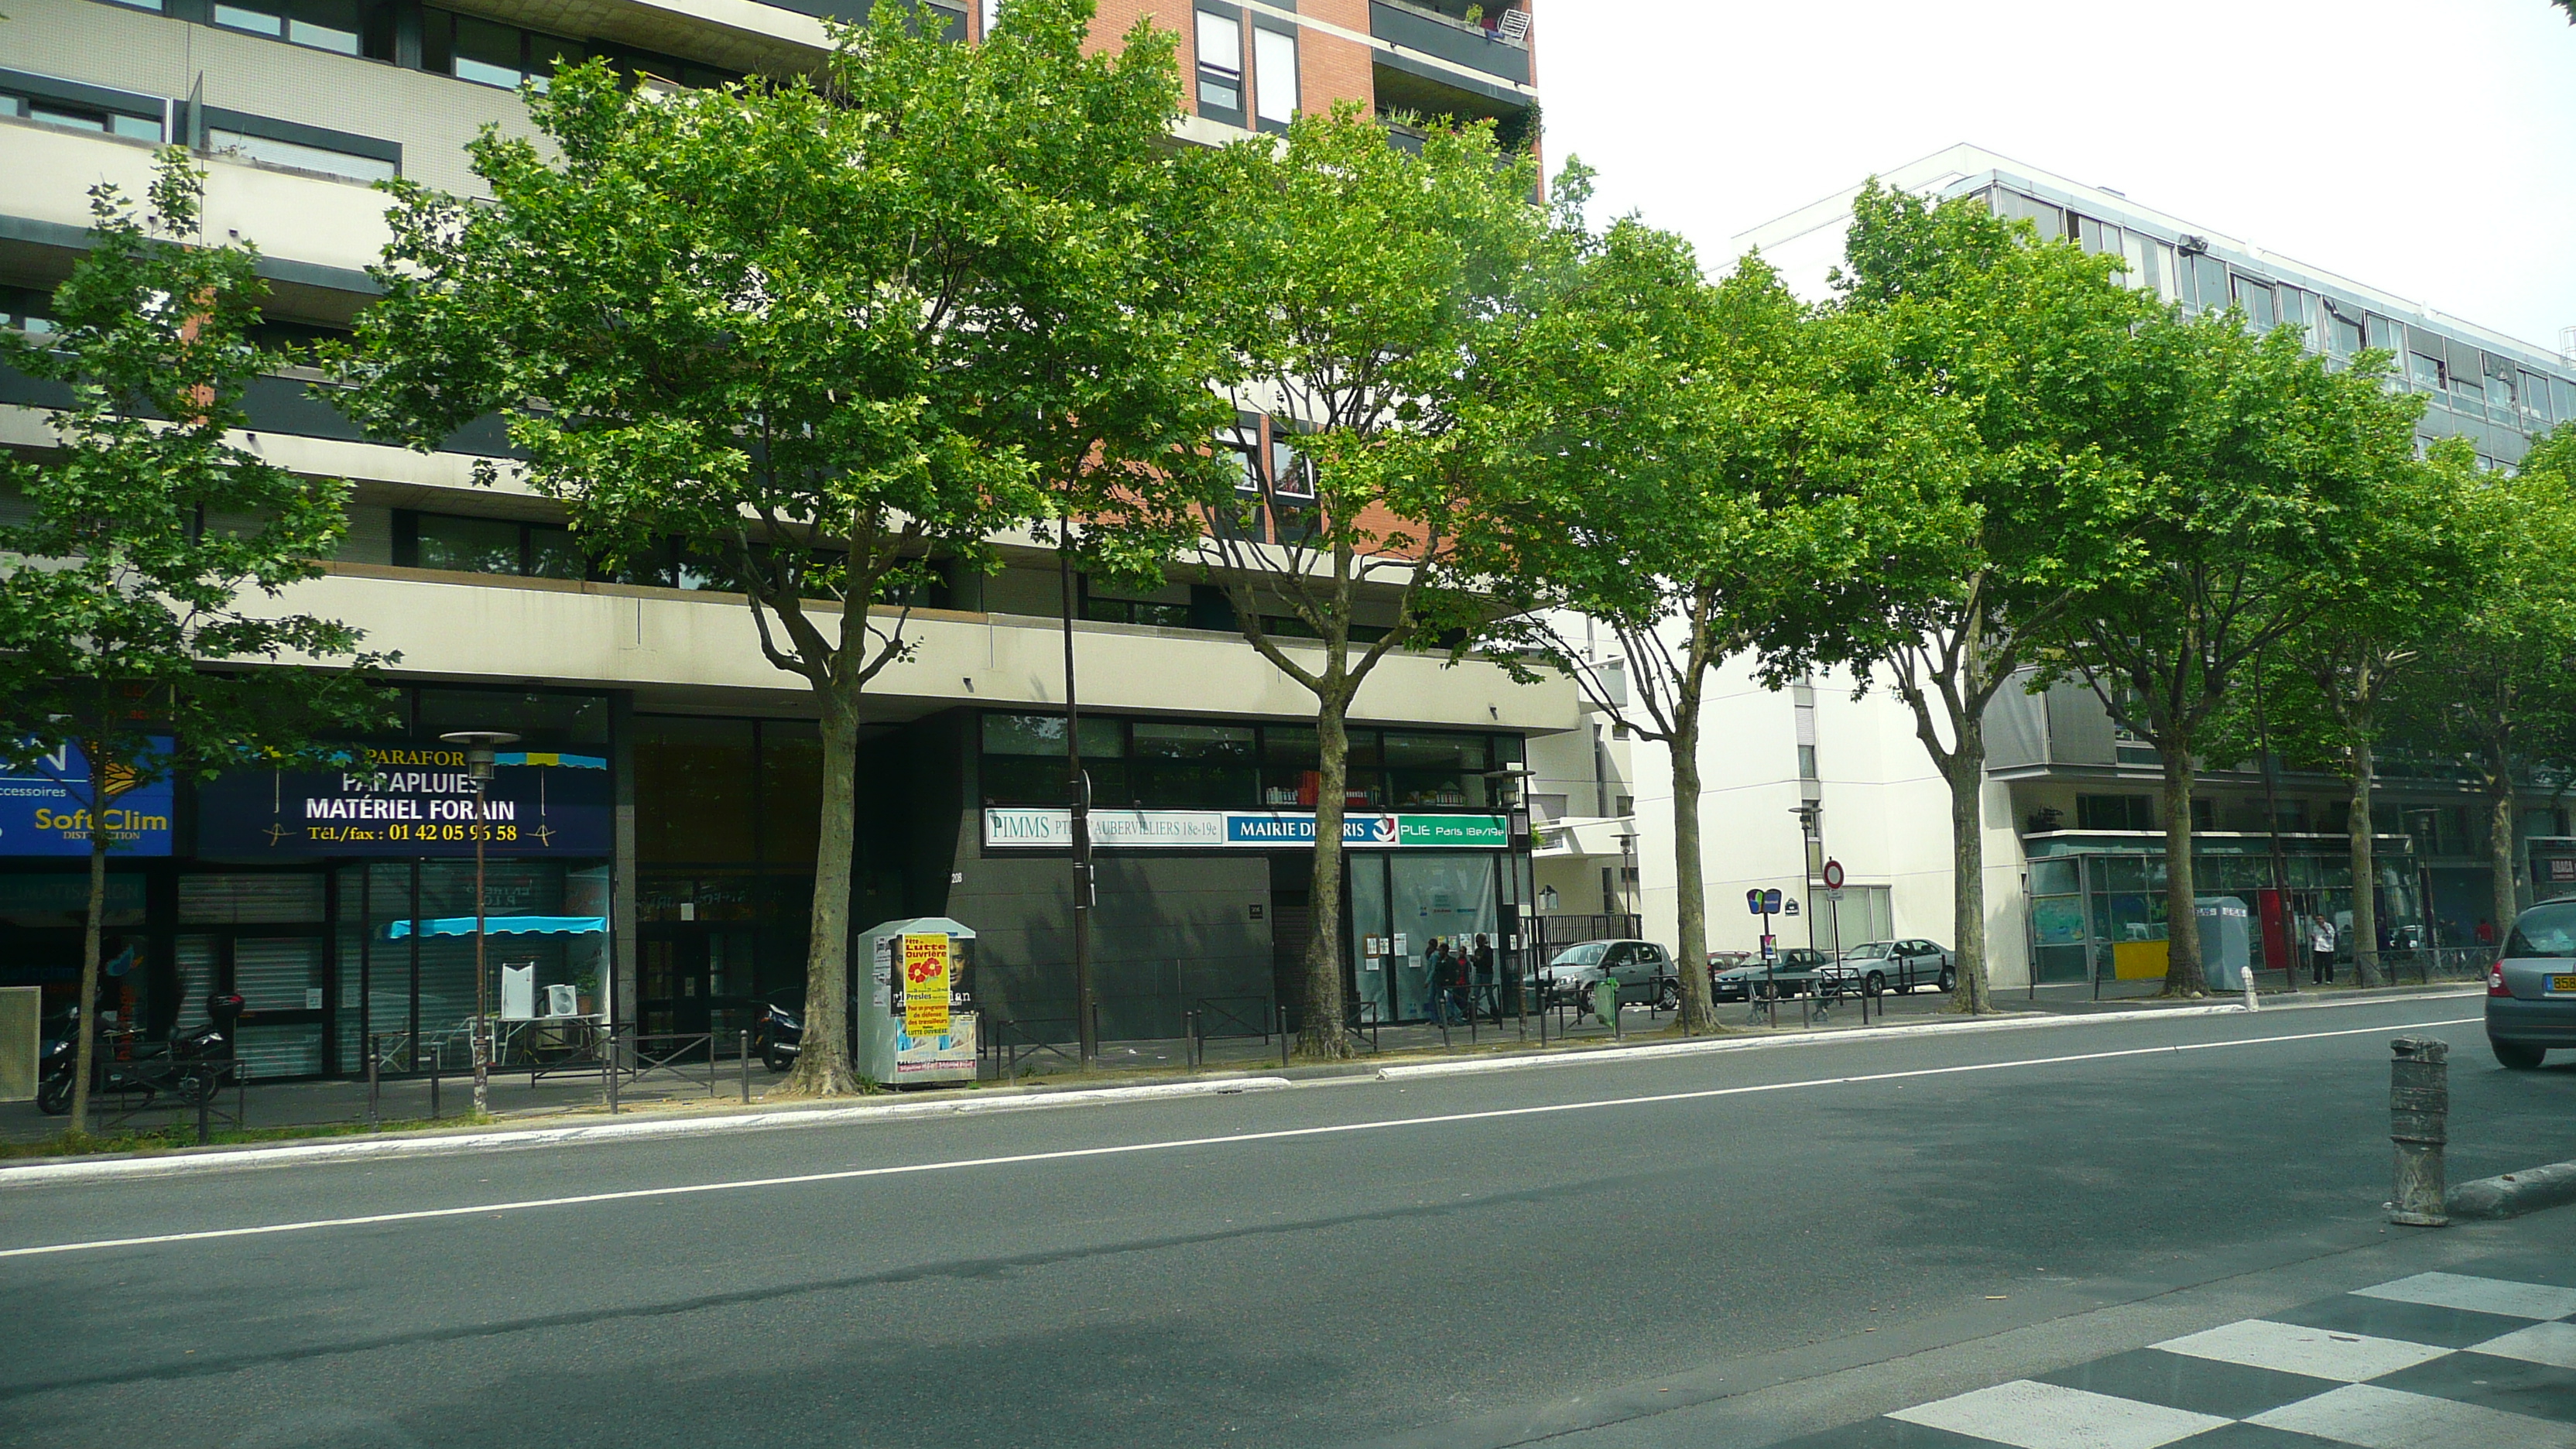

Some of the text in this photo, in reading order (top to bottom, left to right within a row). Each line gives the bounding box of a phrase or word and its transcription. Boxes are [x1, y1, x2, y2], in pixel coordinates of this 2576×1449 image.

[365, 749, 466, 766] PARAFOR
[306, 795, 423, 820] MATÉRIEL
[389, 824, 409, 841] 01
[415, 824, 437, 841] 42
[442, 825, 464, 841] 05
[495, 825, 517, 841] 58
[992, 816, 1050, 838] PIMMS
[1090, 820, 1180, 836] 'AUBERVILLIERS
[1183, 821, 1217, 836] 18e-19e
[1241, 821, 1296, 837] MAIRIE
[1343, 823, 1365, 837] RIS
[1400, 825, 1505, 836] PLIE Paris 18e/19e
